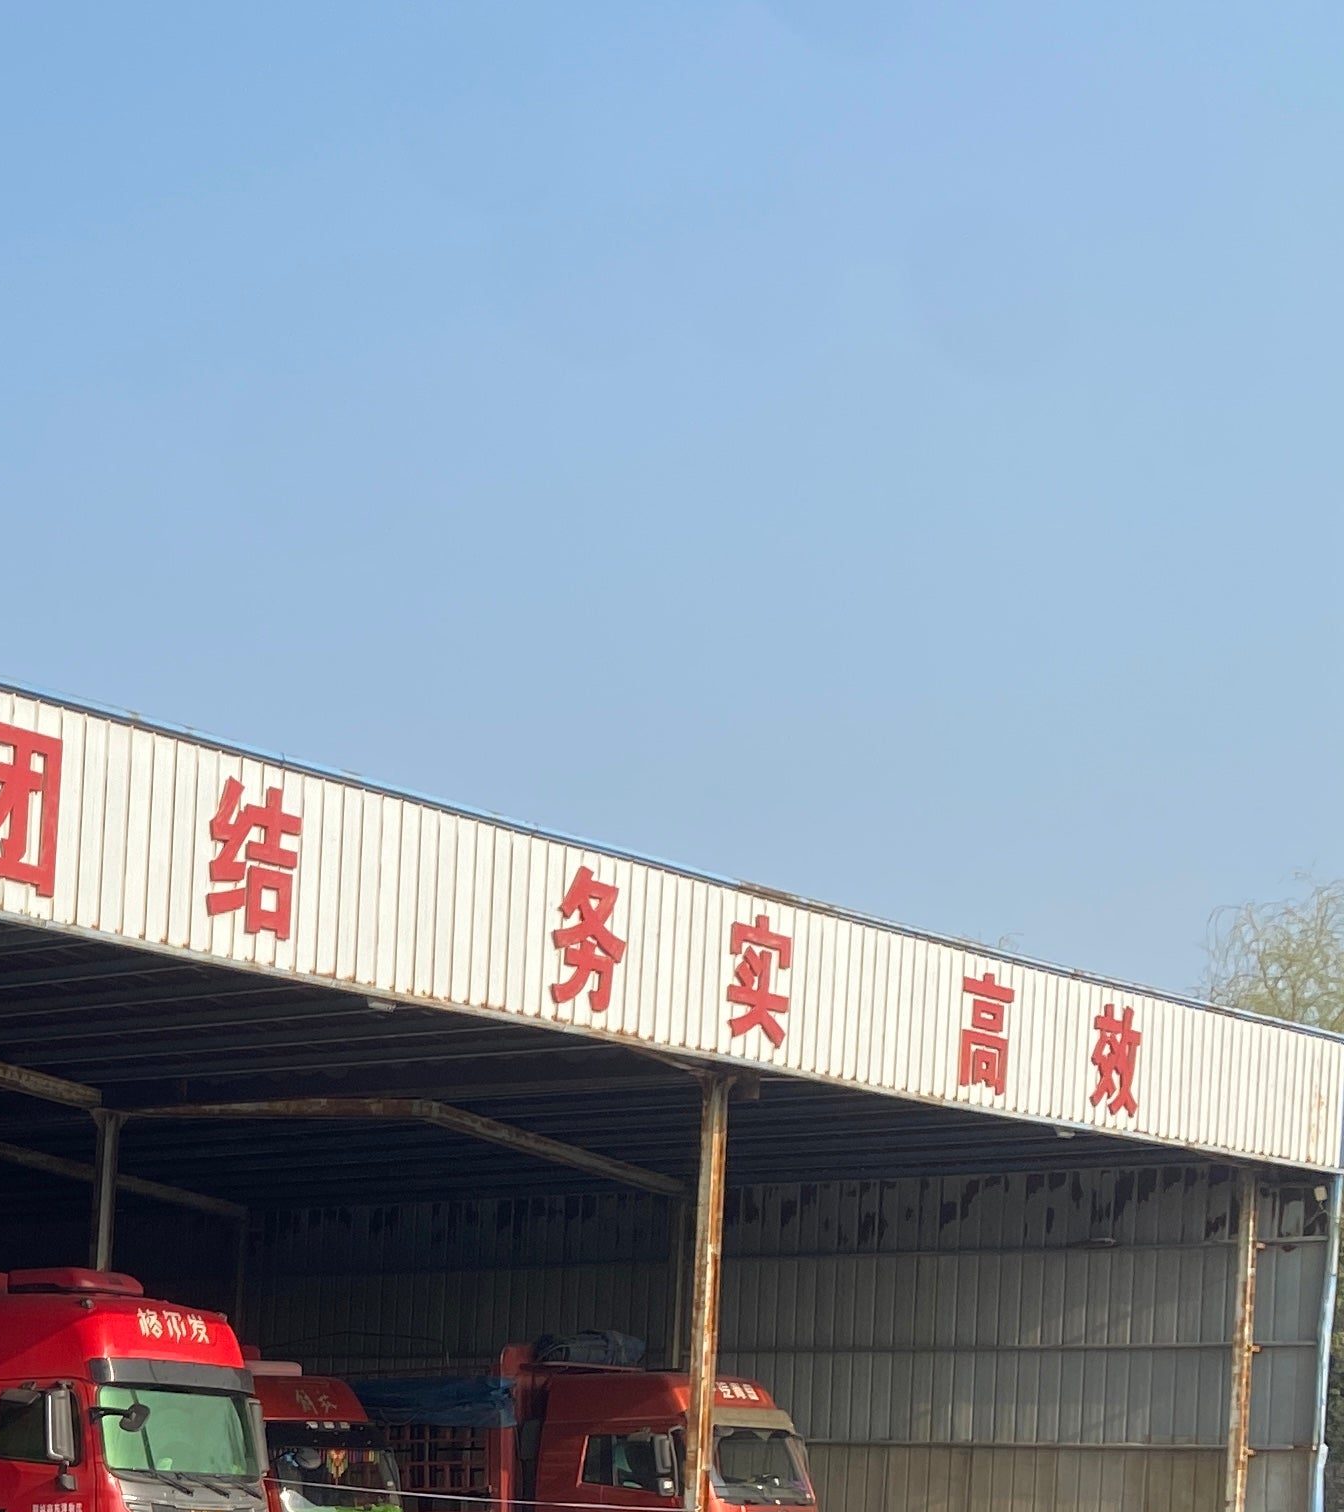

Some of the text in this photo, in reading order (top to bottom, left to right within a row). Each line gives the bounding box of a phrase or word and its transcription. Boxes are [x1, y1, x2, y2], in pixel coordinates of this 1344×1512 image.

[552, 867, 792, 1047] 务实
[959, 973, 1141, 1117] 高效
[137, 1307, 210, 1344] 格尔发
